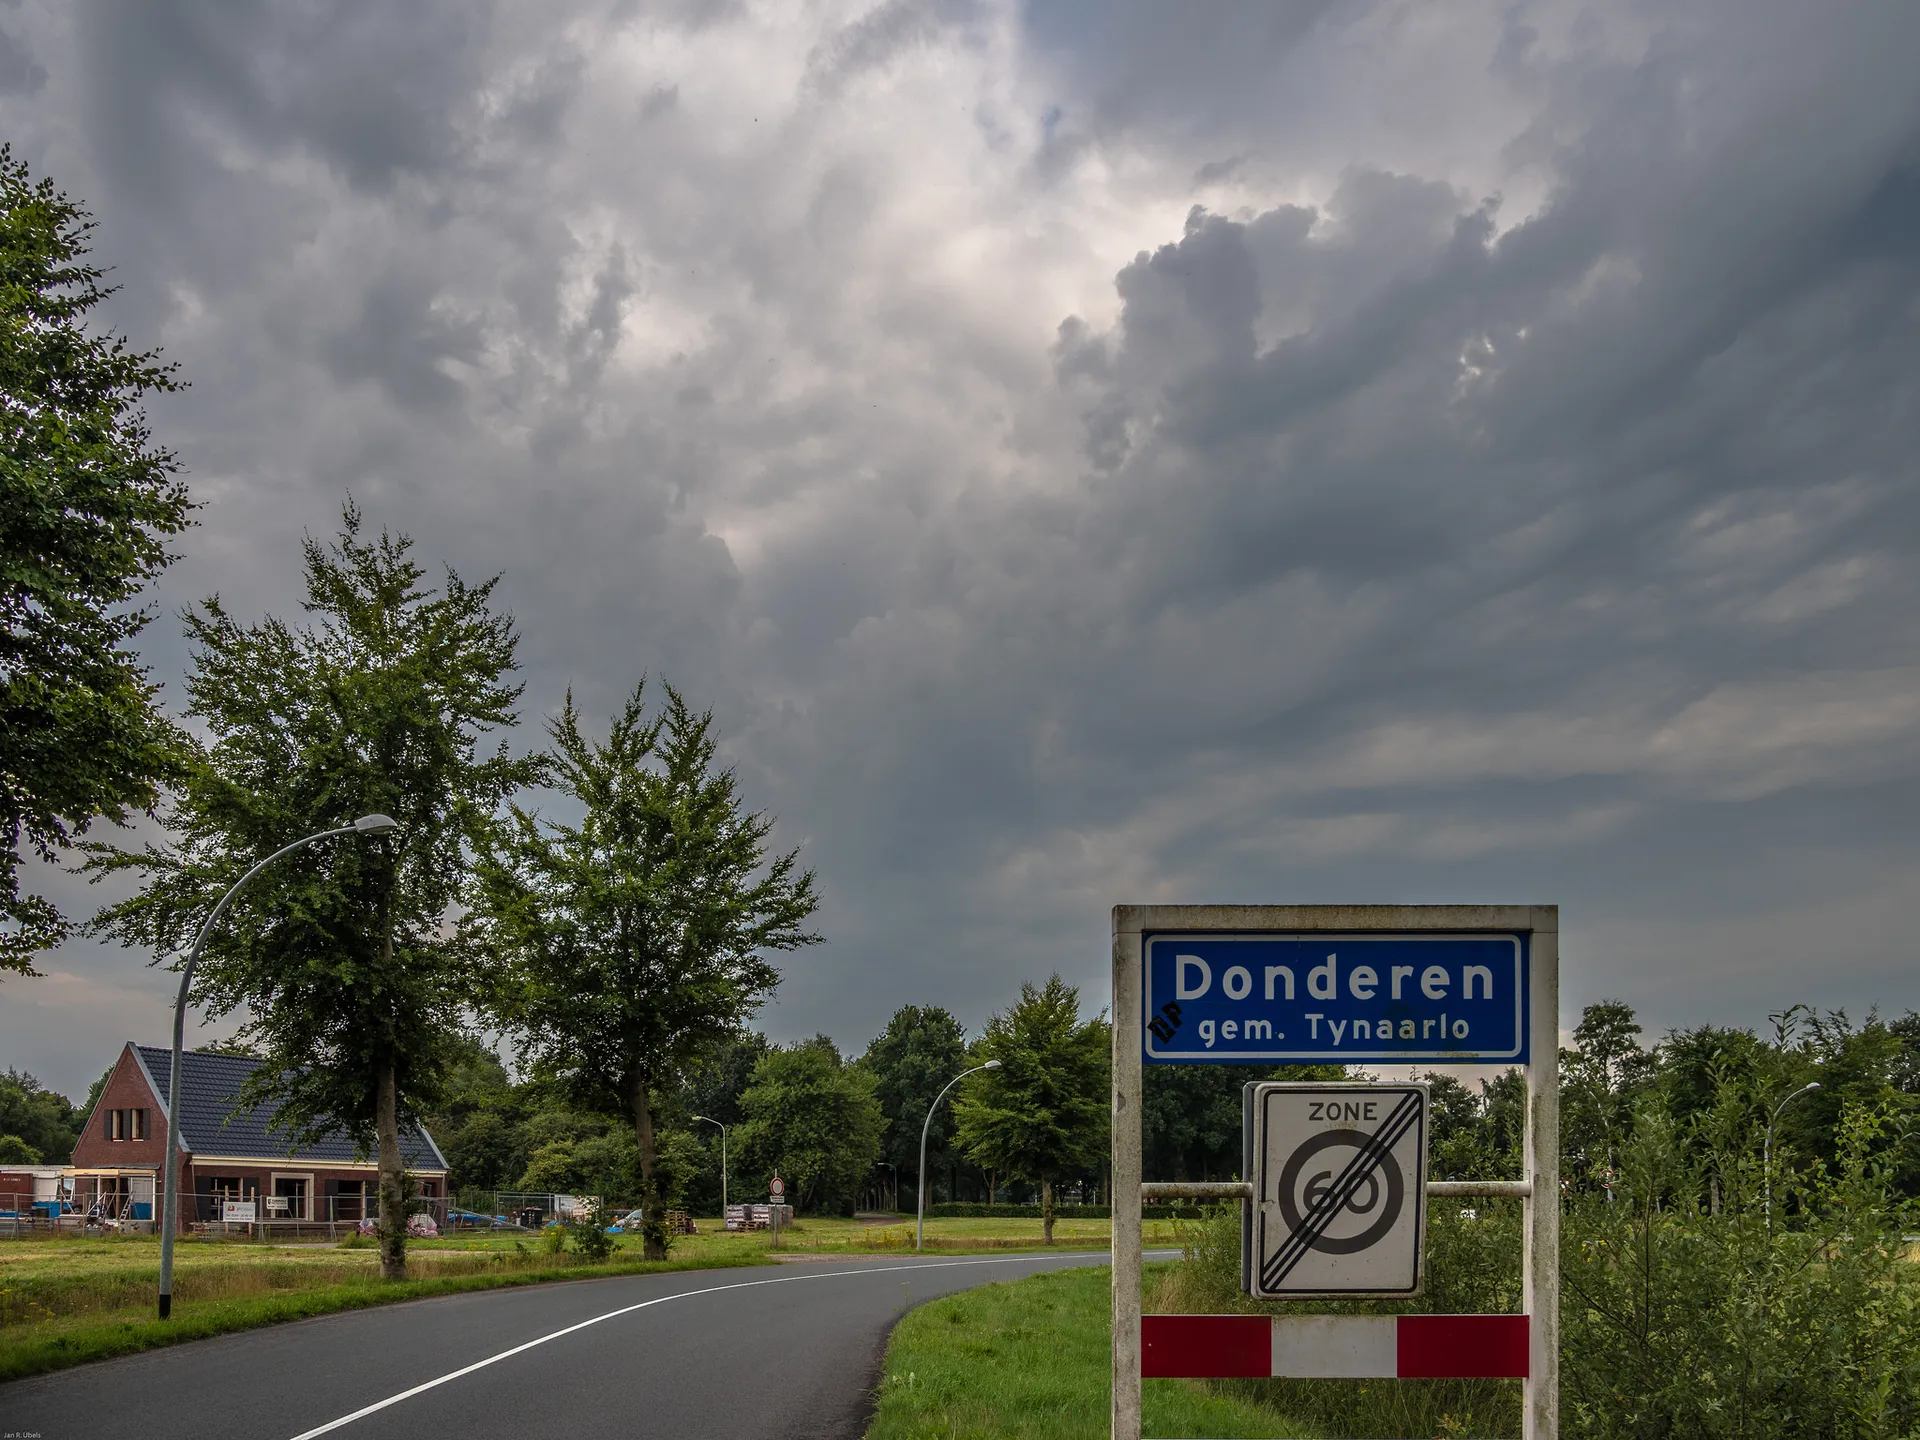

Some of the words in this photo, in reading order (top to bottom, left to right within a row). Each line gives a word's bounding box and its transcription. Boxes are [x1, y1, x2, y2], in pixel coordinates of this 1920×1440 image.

[1175, 953, 1494, 1000] Donderen
[1199, 1019, 1285, 1048] gem.
[1304, 1013, 1470, 1045] Tynaarlo
[1308, 1102, 1378, 1121] ZONE
[1302, 1170, 1380, 1215] 60
